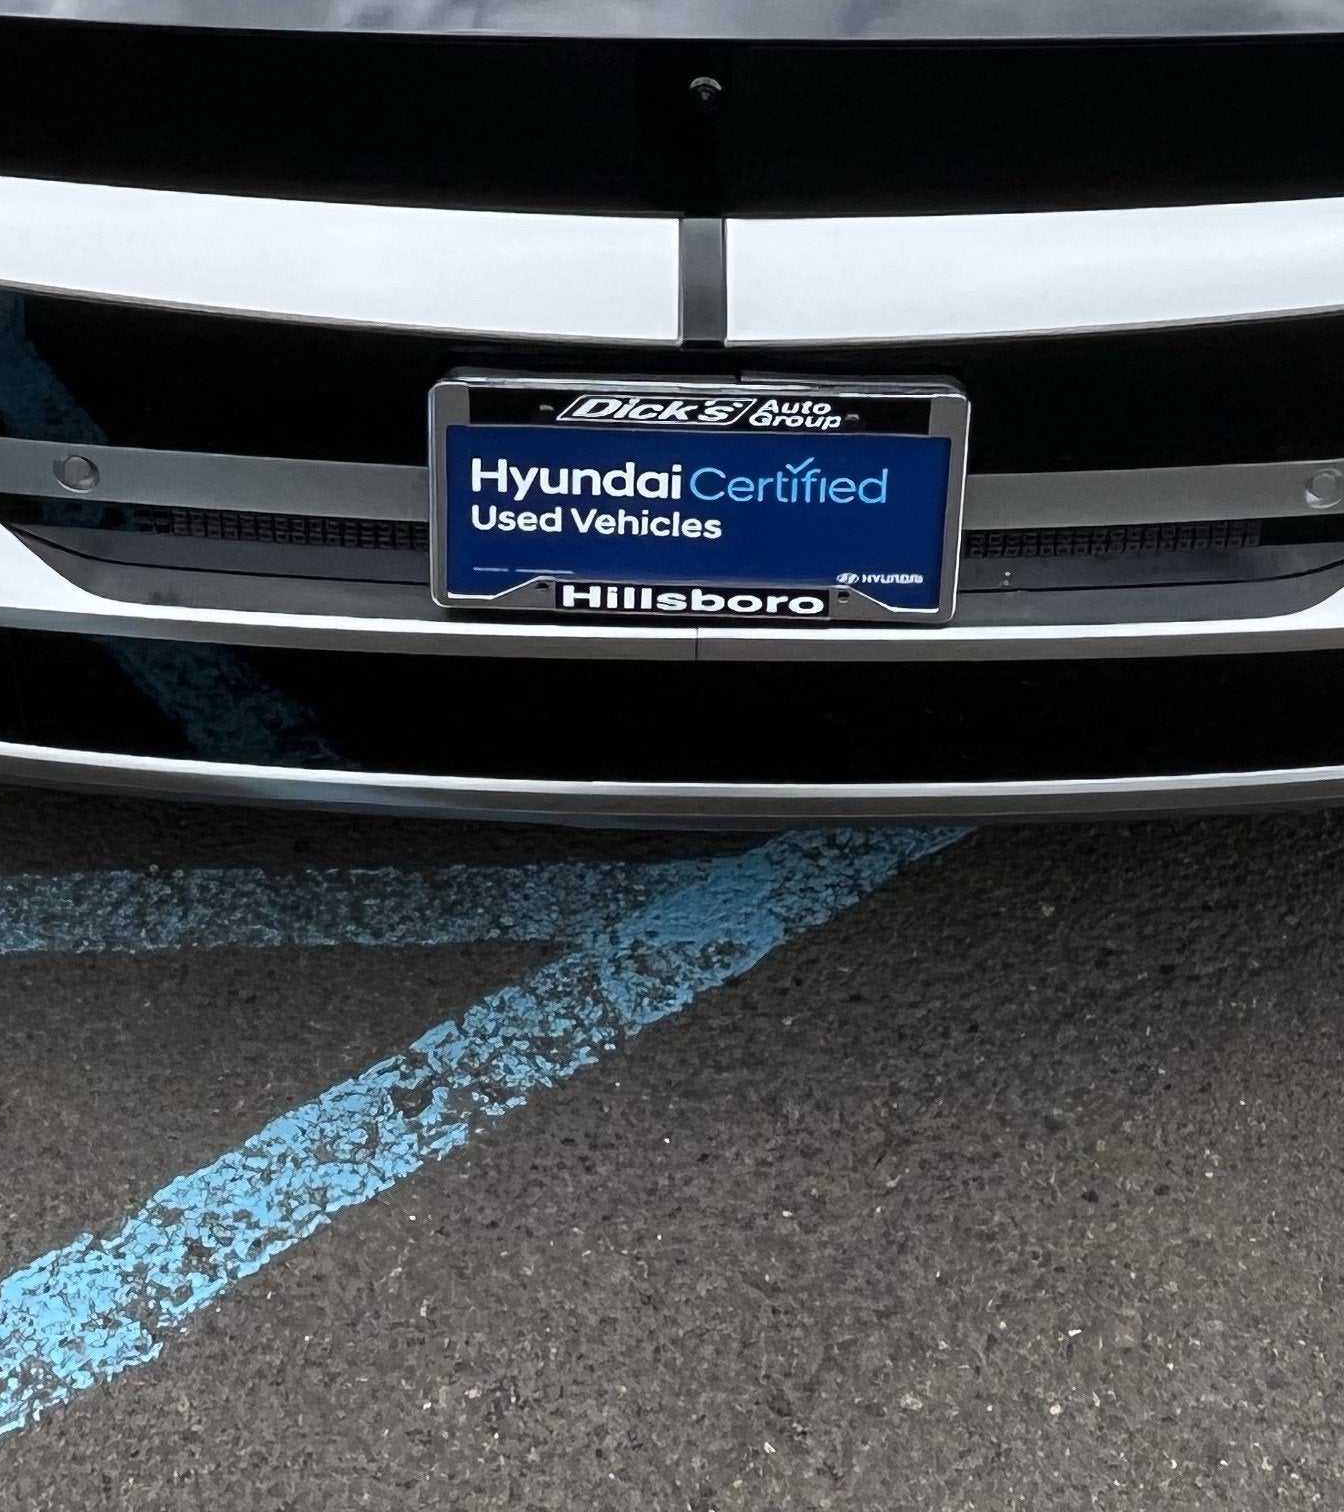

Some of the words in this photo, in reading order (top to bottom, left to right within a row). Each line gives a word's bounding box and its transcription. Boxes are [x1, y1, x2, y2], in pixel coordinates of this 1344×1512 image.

[757, 399, 831, 415] Auto
[749, 414, 842, 431] Group
[471, 457, 682, 500] Hyundai
[689, 457, 888, 504] Certified
[471, 505, 562, 532] Used
[570, 508, 722, 539] Vehicles
[562, 585, 824, 615] Hillsboro
